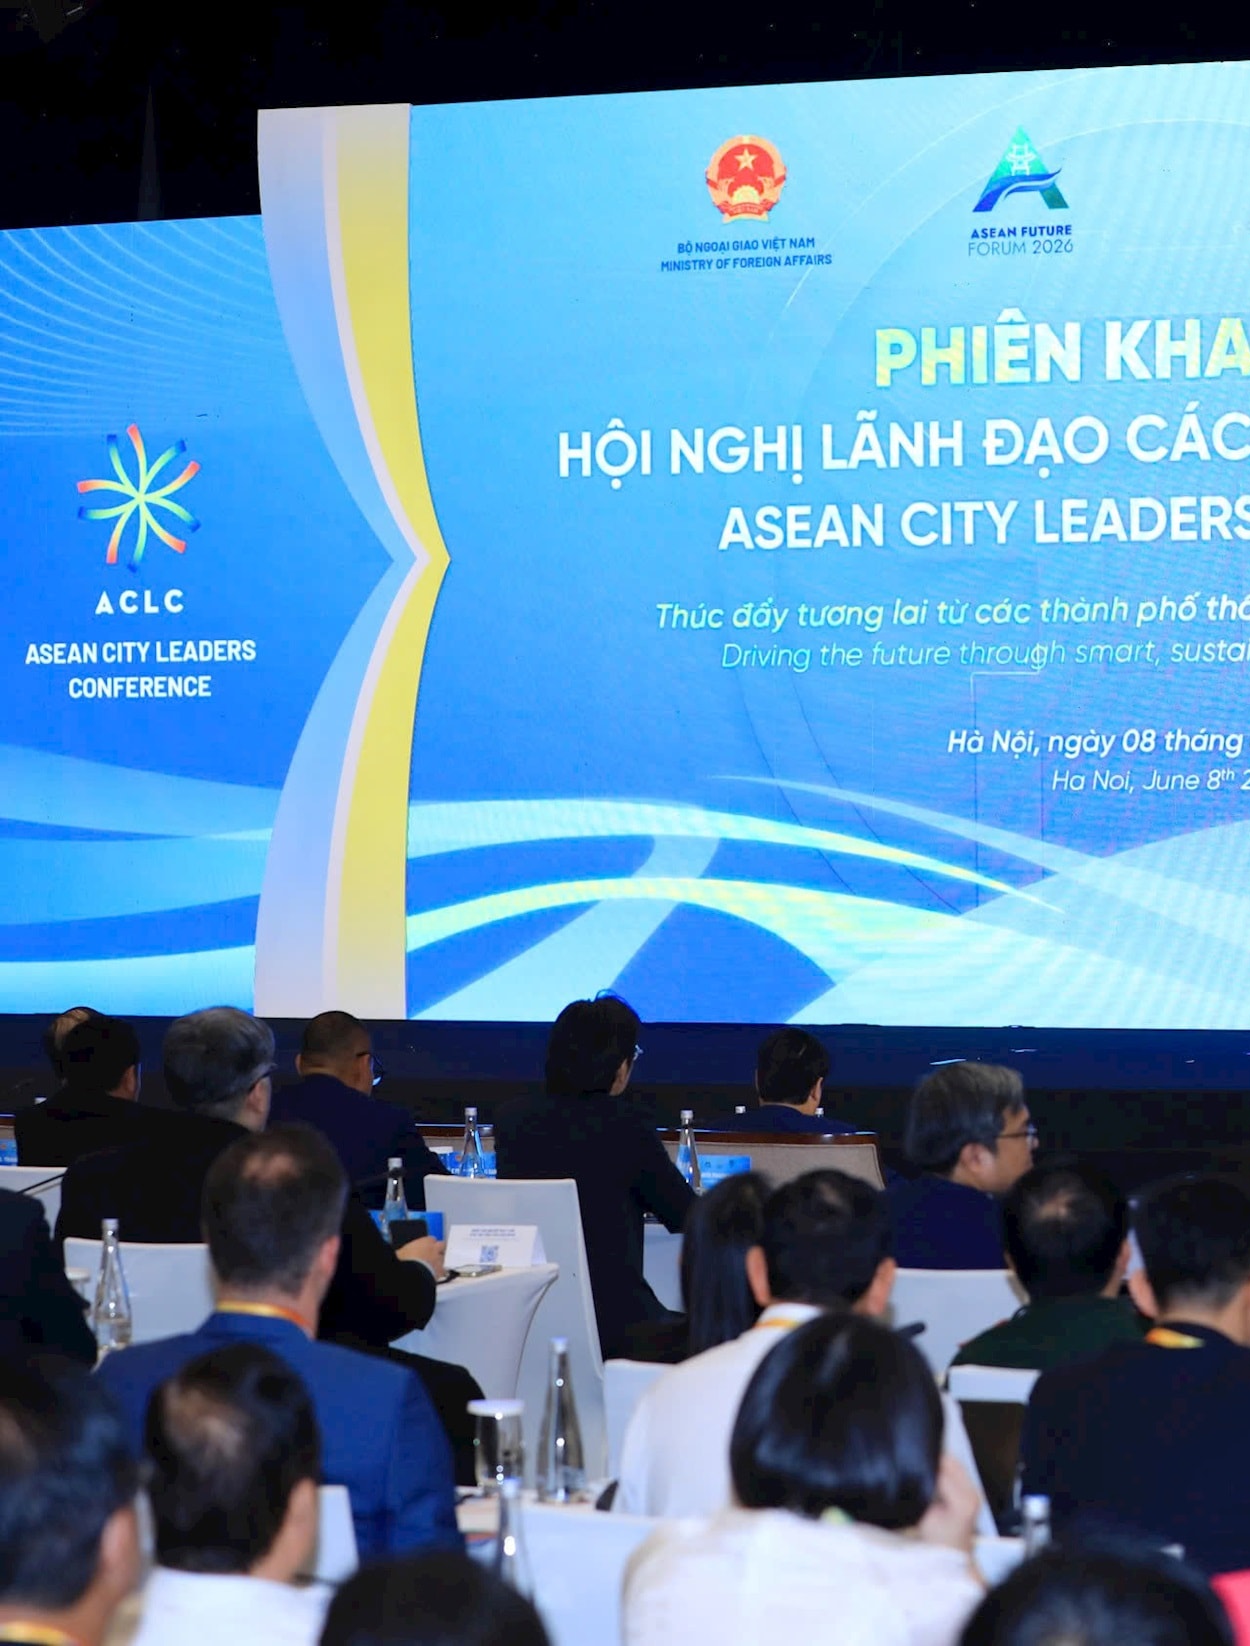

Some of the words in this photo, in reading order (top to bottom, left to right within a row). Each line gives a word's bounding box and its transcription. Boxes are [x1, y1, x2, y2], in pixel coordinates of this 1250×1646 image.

[971, 227, 1016, 239] ASEAN
[1021, 225, 1072, 237] FUTURE
[695, 241, 729, 254] NGOẠI
[732, 240, 758, 251] GIAO
[761, 236, 787, 252] VIỆT
[789, 237, 815, 249] NAM
[968, 241, 1026, 256] FORUM
[1033, 239, 1073, 254] 2026
[661, 259, 713, 272] MINISTRY
[716, 258, 731, 269] OF
[733, 256, 781, 269] FOREIGN
[784, 254, 832, 266] AFFAIRS
[874, 307, 1081, 388] PHIÊN
[558, 418, 651, 489] HỘI
[670, 424, 803, 485] NGHỊ
[821, 410, 963, 471] LÃNH
[982, 415, 1109, 479] ĐẠO
[718, 503, 883, 550] ASEAN
[900, 500, 1019, 547] CITY
[95, 589, 184, 614] ACLC
[656, 603, 723, 630] Thúc
[733, 596, 789, 633] đẩy
[797, 604, 883, 632] tương
[892, 599, 926, 625] lai
[937, 599, 967, 625] từ
[975, 600, 1031, 625] các
[1040, 597, 1128, 623] thành
[1136, 591, 1200, 628] phố
[25, 642, 97, 664] ASEAN
[102, 641, 150, 663] CITY
[156, 639, 256, 663] LEADERS
[721, 644, 811, 673] Driving
[820, 643, 863, 666] the
[872, 641, 951, 666] future
[959, 641, 1066, 671] through
[1075, 641, 1160, 666] smart,
[69, 676, 211, 699] CONFERENCE
[947, 730, 983, 754] Hà
[991, 729, 1039, 759] Nội,
[1047, 730, 1115, 758] ngày
[1121, 728, 1156, 752] 08
[1164, 727, 1242, 757] tháng
[1051, 769, 1085, 791] Ha
[1093, 768, 1133, 793] Noi,
[1142, 768, 1199, 791] June
